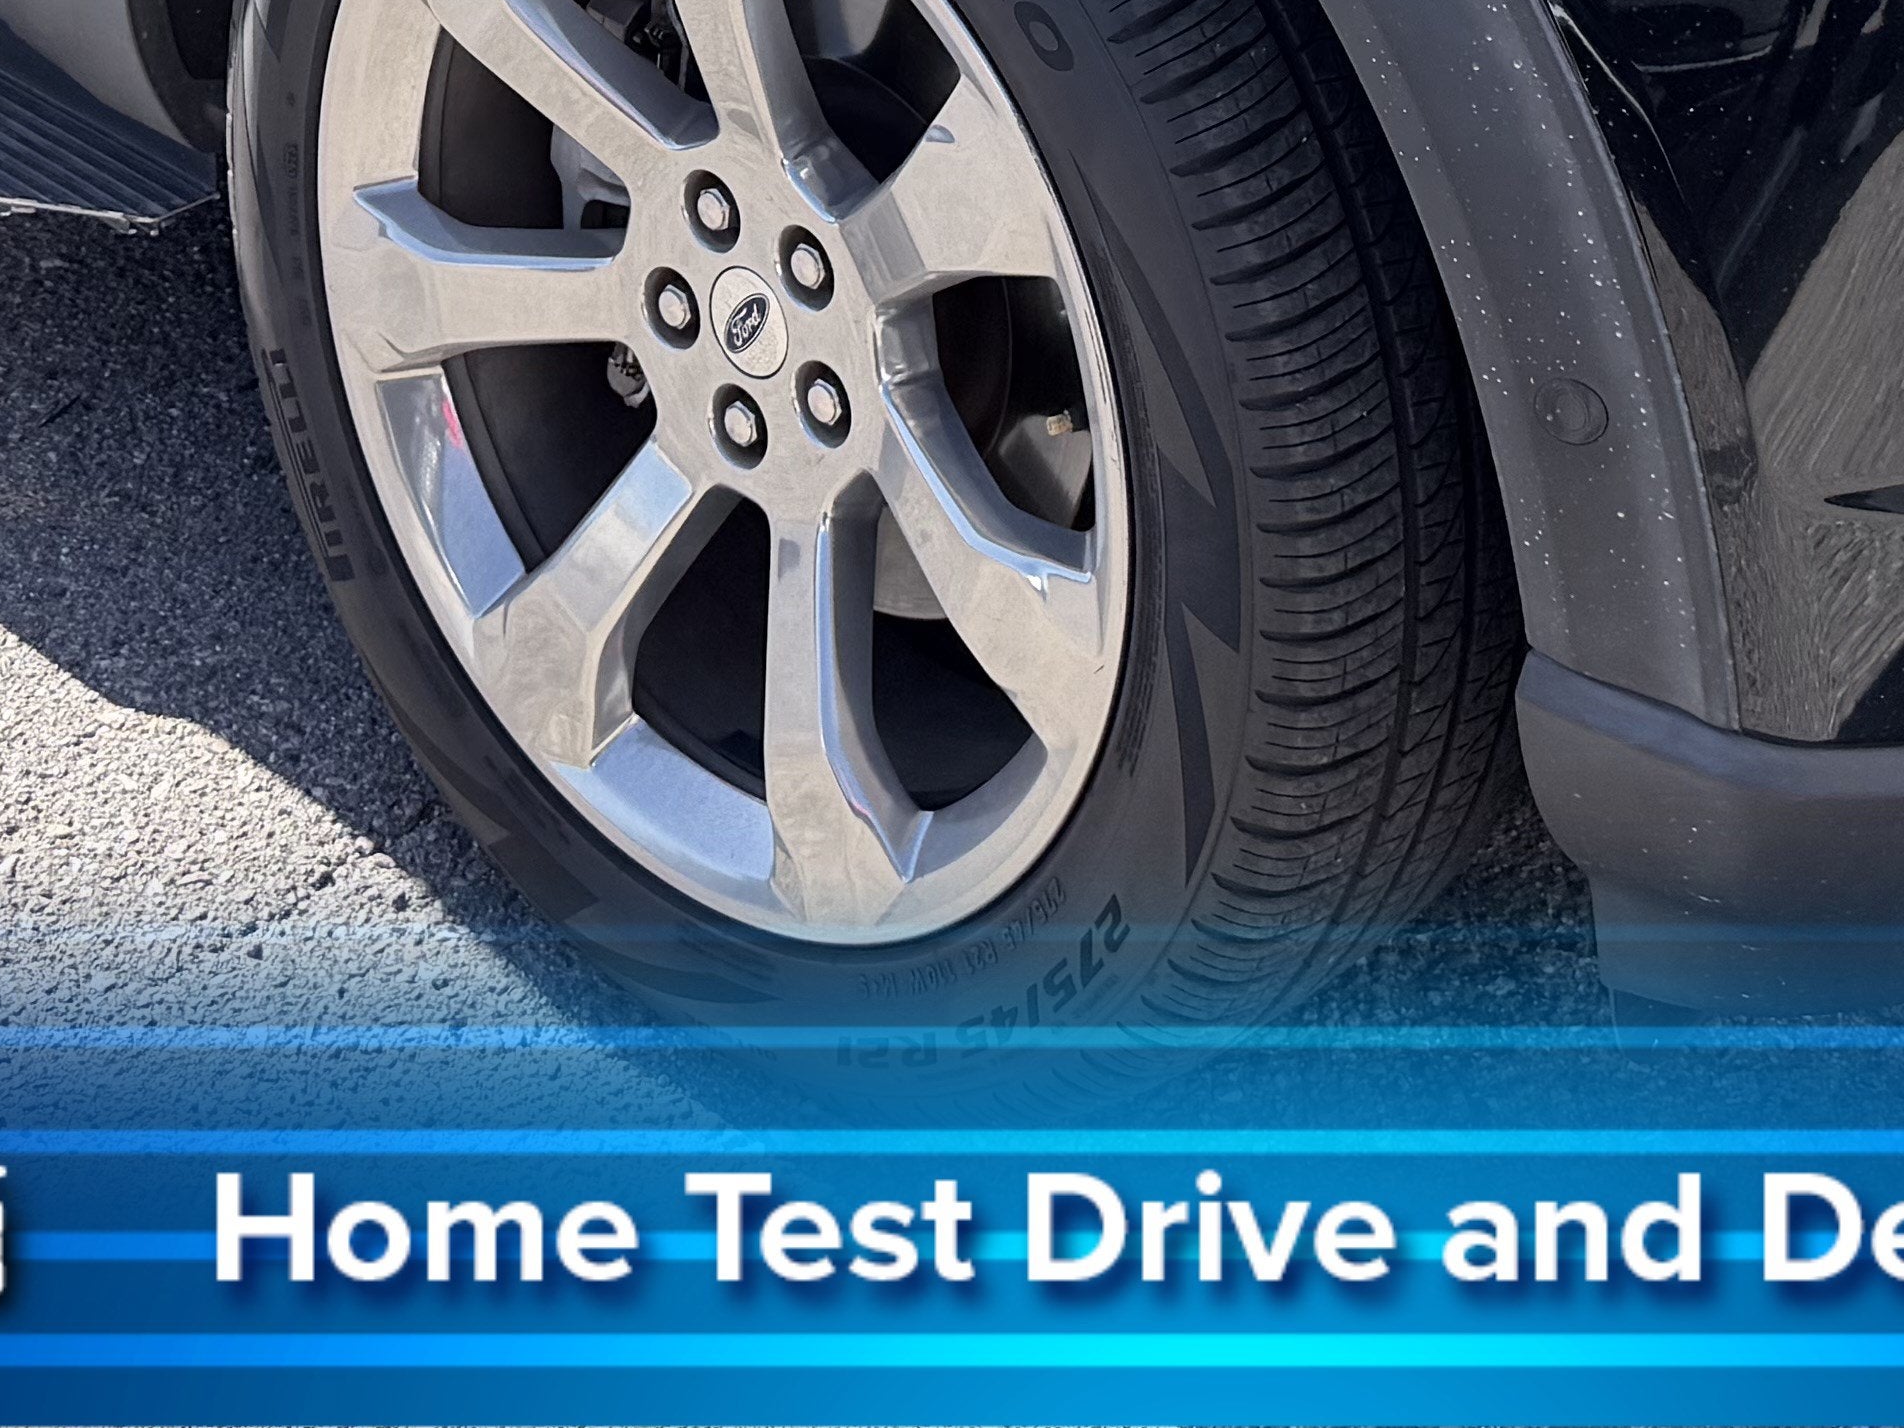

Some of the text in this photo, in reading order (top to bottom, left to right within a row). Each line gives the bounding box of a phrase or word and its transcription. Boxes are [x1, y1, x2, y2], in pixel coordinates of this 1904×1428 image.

[261, 348, 355, 581] PIRELLI
[836, 893, 1131, 1069] 275/45 R21
